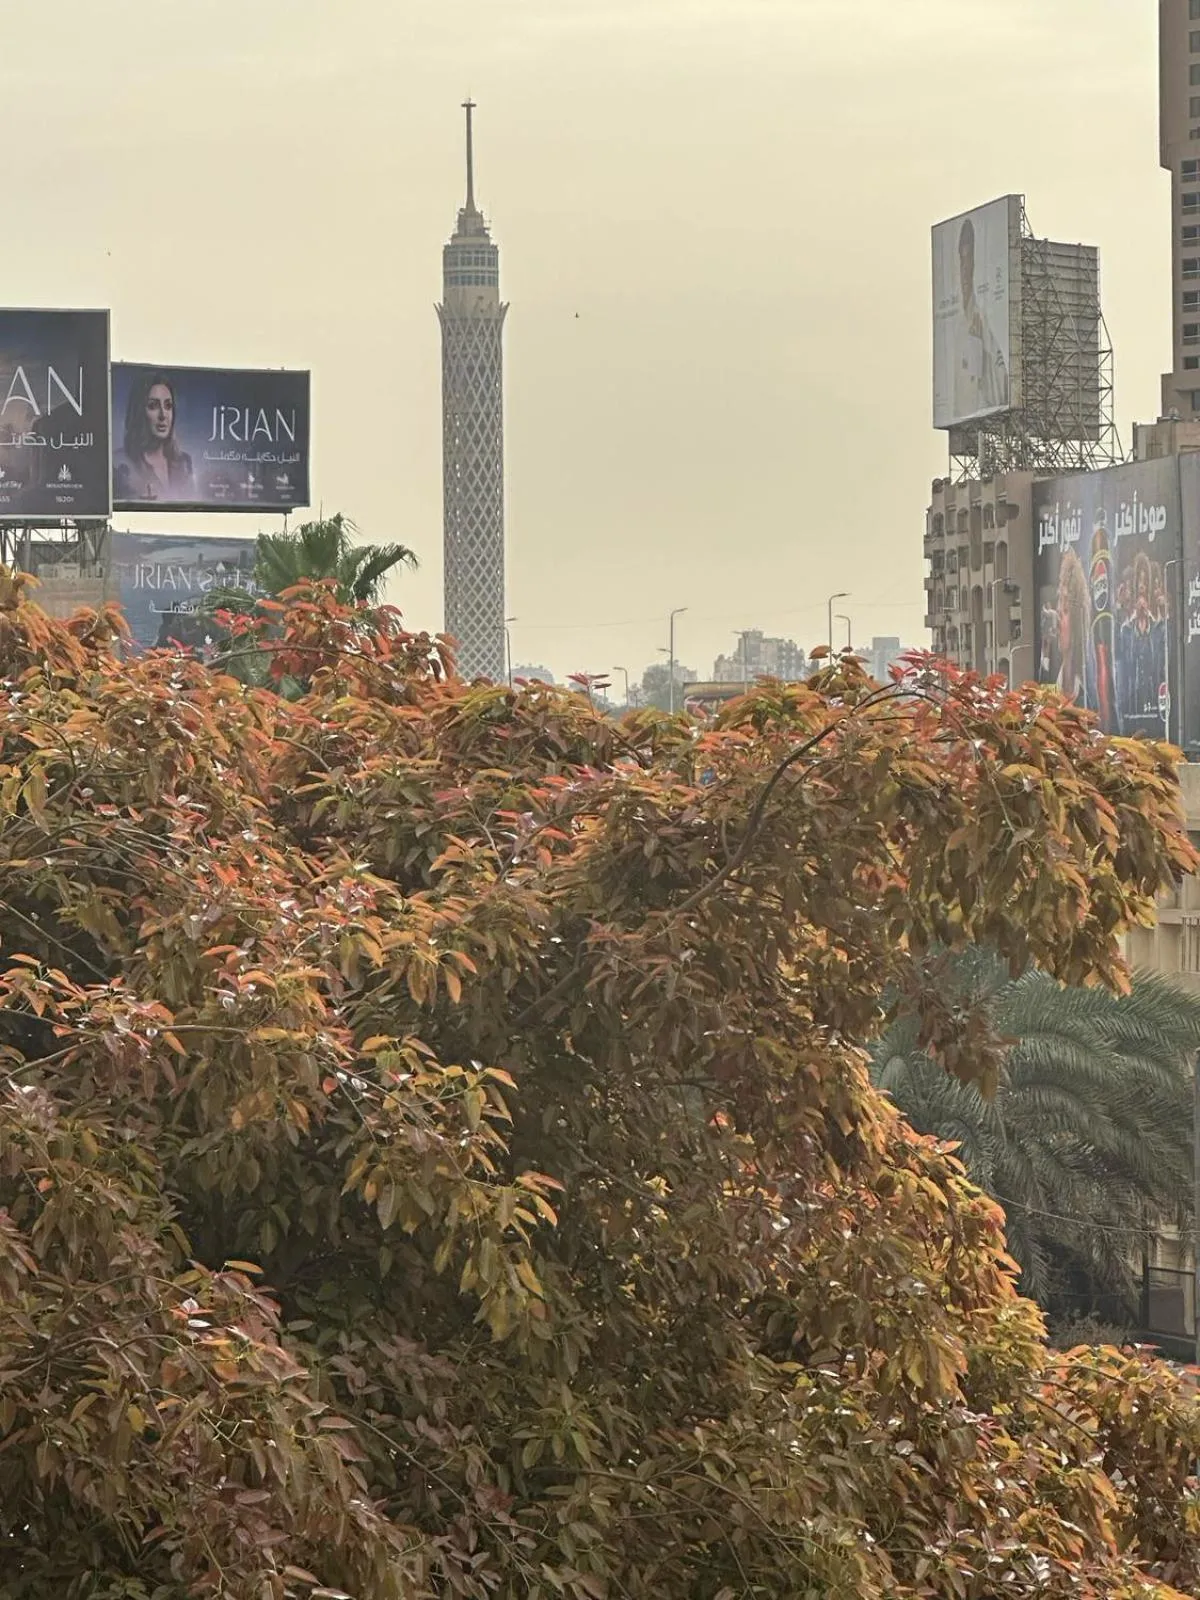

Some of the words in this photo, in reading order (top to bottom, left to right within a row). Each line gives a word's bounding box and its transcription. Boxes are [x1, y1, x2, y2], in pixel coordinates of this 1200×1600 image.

[0, 431, 47, 449] حكايت
[50, 432, 94, 449] النيل
[277, 452, 301, 465] النيل
[1139, 501, 1167, 542] صودا
